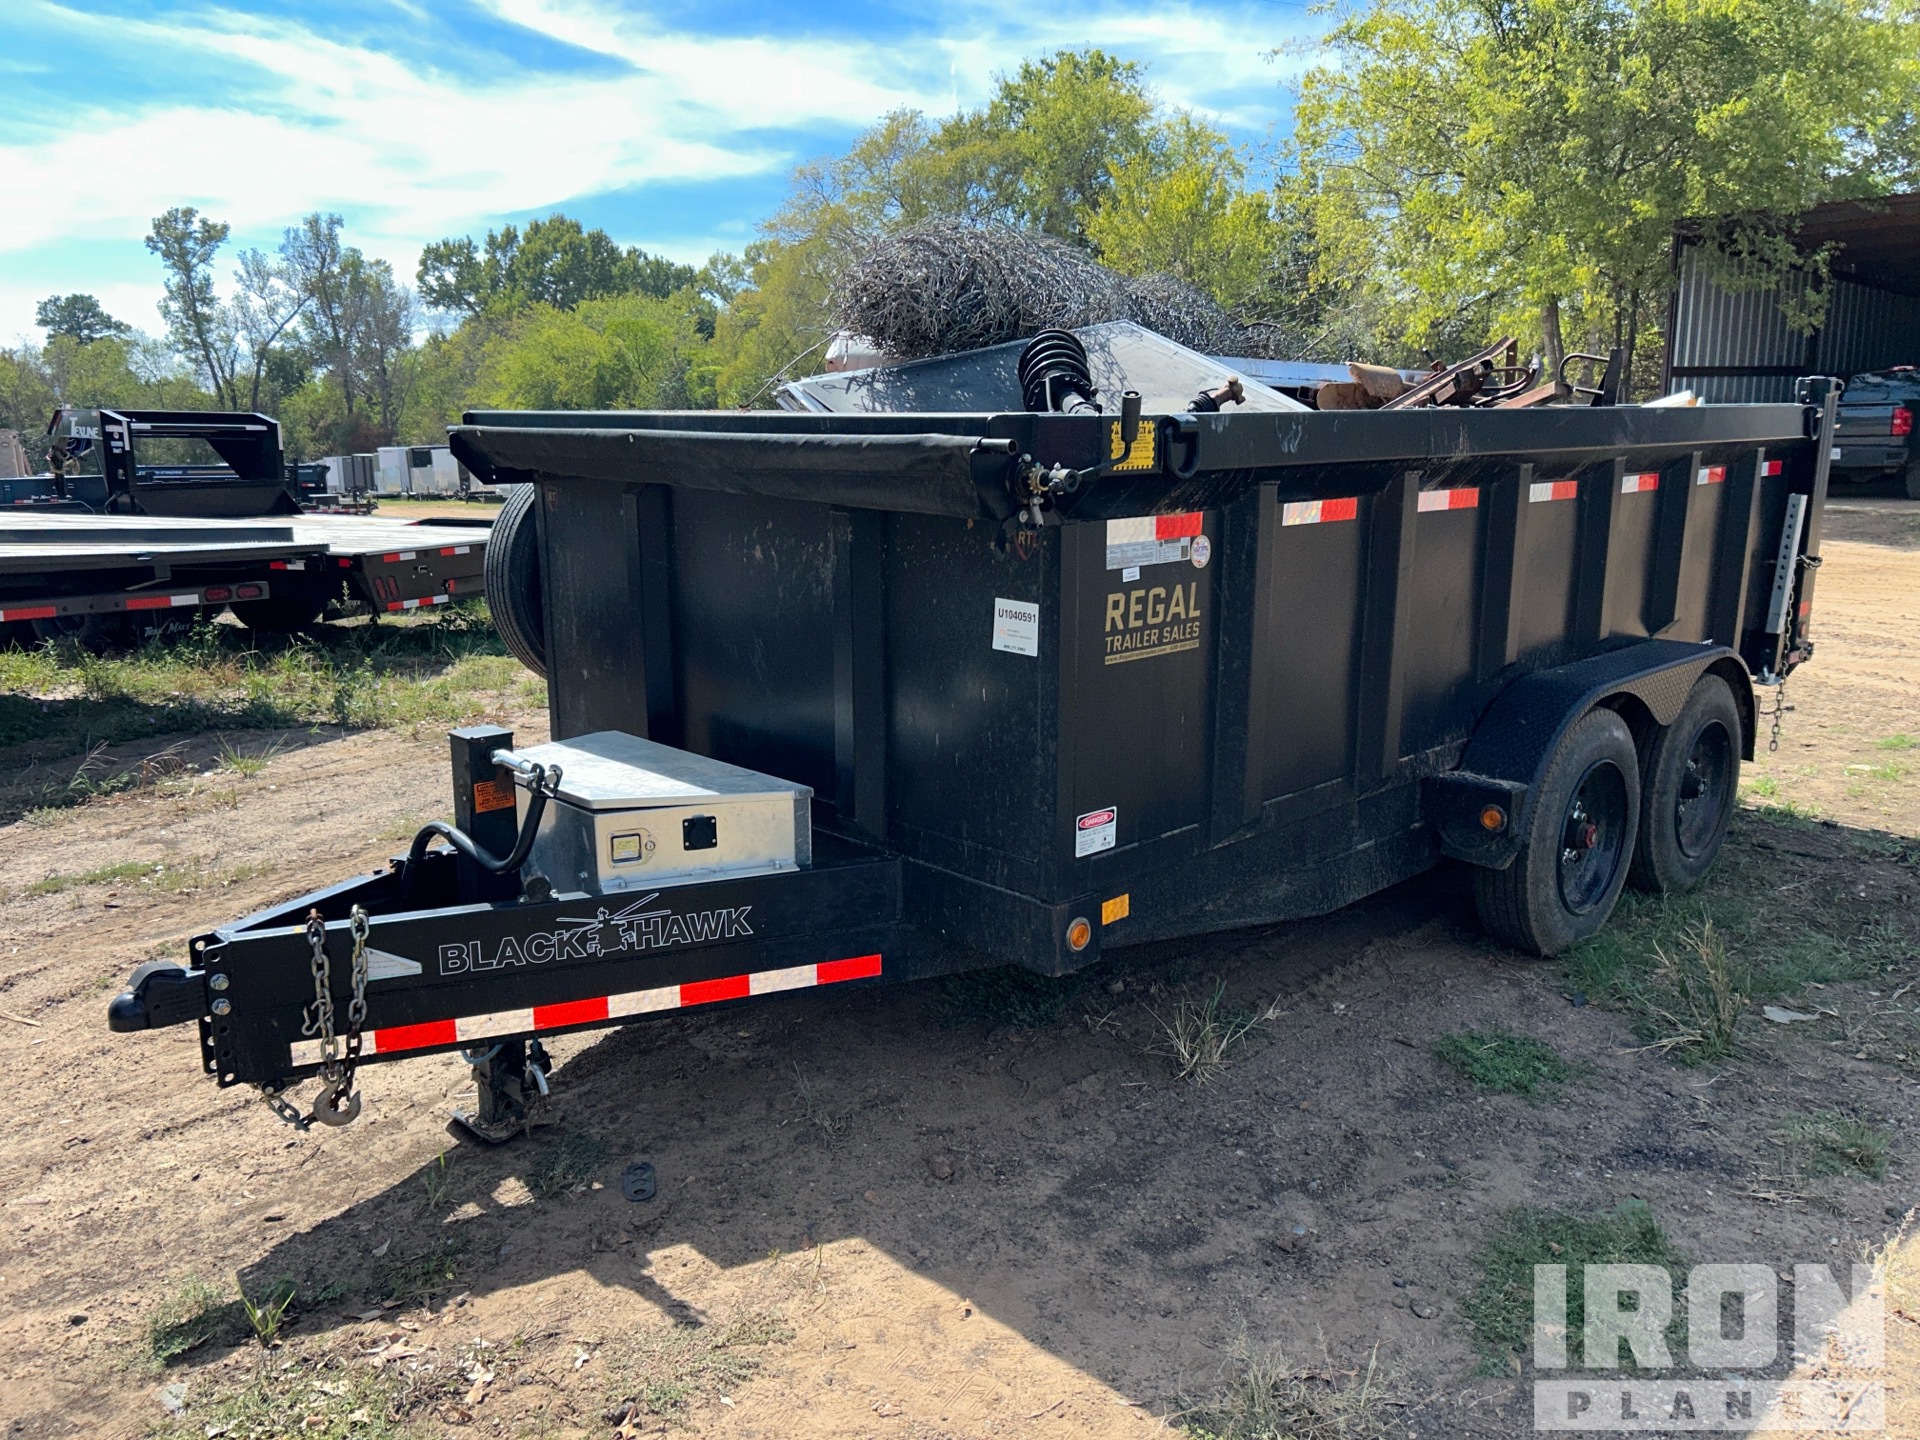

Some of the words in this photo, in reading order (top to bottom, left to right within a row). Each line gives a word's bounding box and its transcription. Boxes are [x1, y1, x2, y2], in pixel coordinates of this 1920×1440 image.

[998, 607, 1036, 623] U1040591
[1105, 582, 1200, 632] REGAL
[1105, 629, 1159, 653] TRAILER
[1163, 621, 1200, 643] SALES
[1084, 814, 1109, 826] DANGER
[439, 929, 586, 976] BLACK
[633, 906, 754, 950] HAWK
